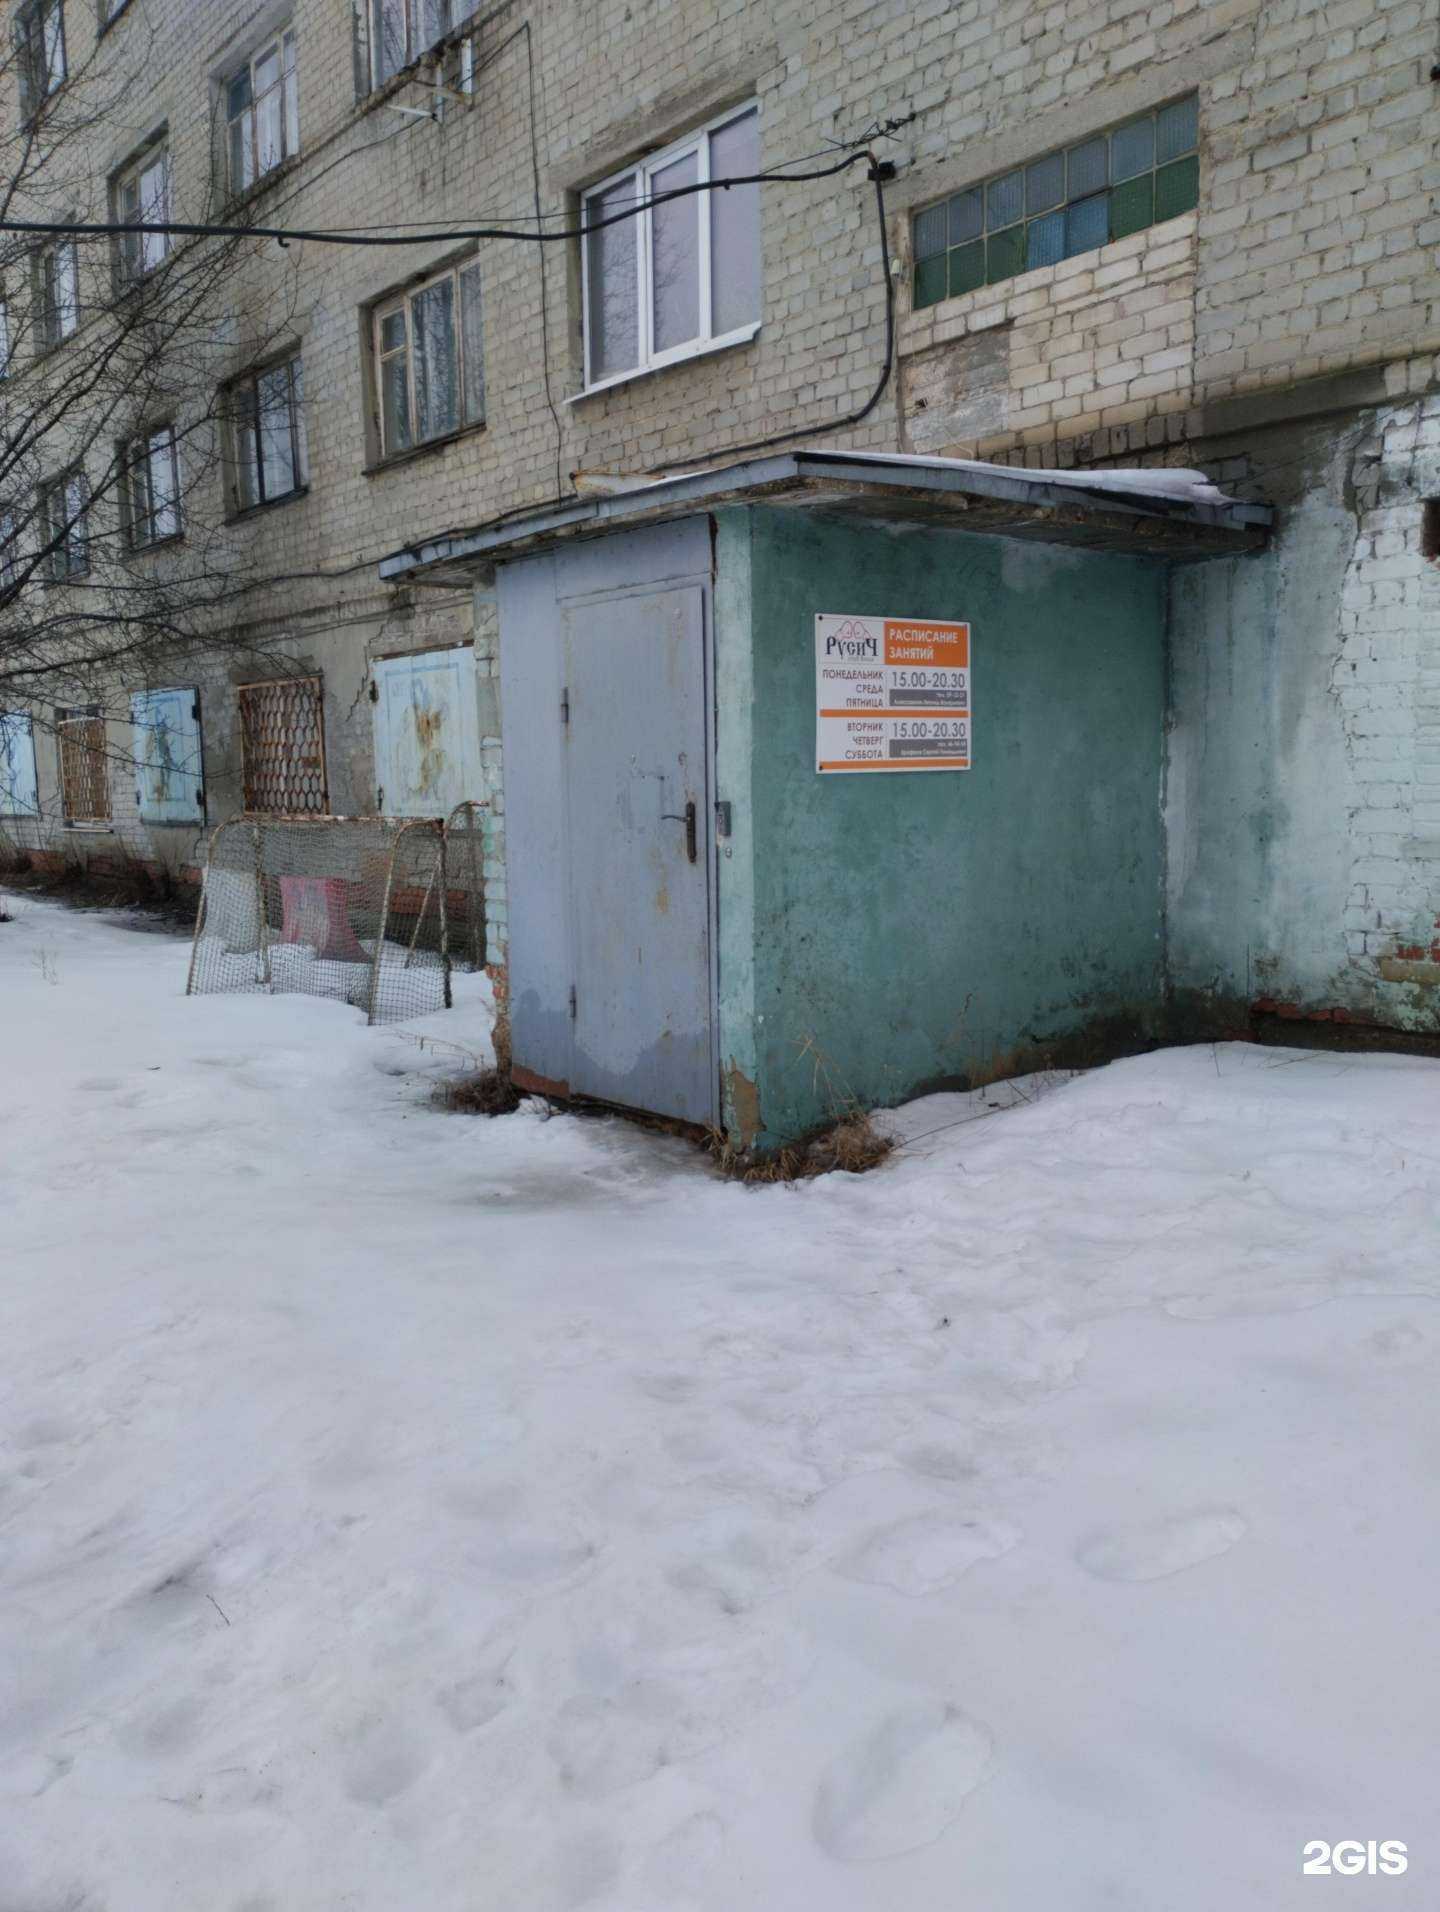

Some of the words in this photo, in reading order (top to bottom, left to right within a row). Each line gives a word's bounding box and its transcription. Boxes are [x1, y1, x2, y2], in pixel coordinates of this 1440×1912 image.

[889, 628, 959, 644] РАСПИСАНИЕ
[889, 646, 934, 660] ЗАНЯТИЙ
[822, 669, 884, 680] ПОНЕДЕЛЬНИК
[892, 671, 966, 688] 15.00-20.30
[855, 684, 884, 694] СРЕДА
[846, 698, 884, 708] ПЯТНИЦА
[847, 722, 884, 732] ВТОРНИК
[893, 722, 967, 738] 15.00-20.30
[852, 736, 884, 746] ЧЕТВЕРГ
[845, 750, 884, 759] СУББОТА
